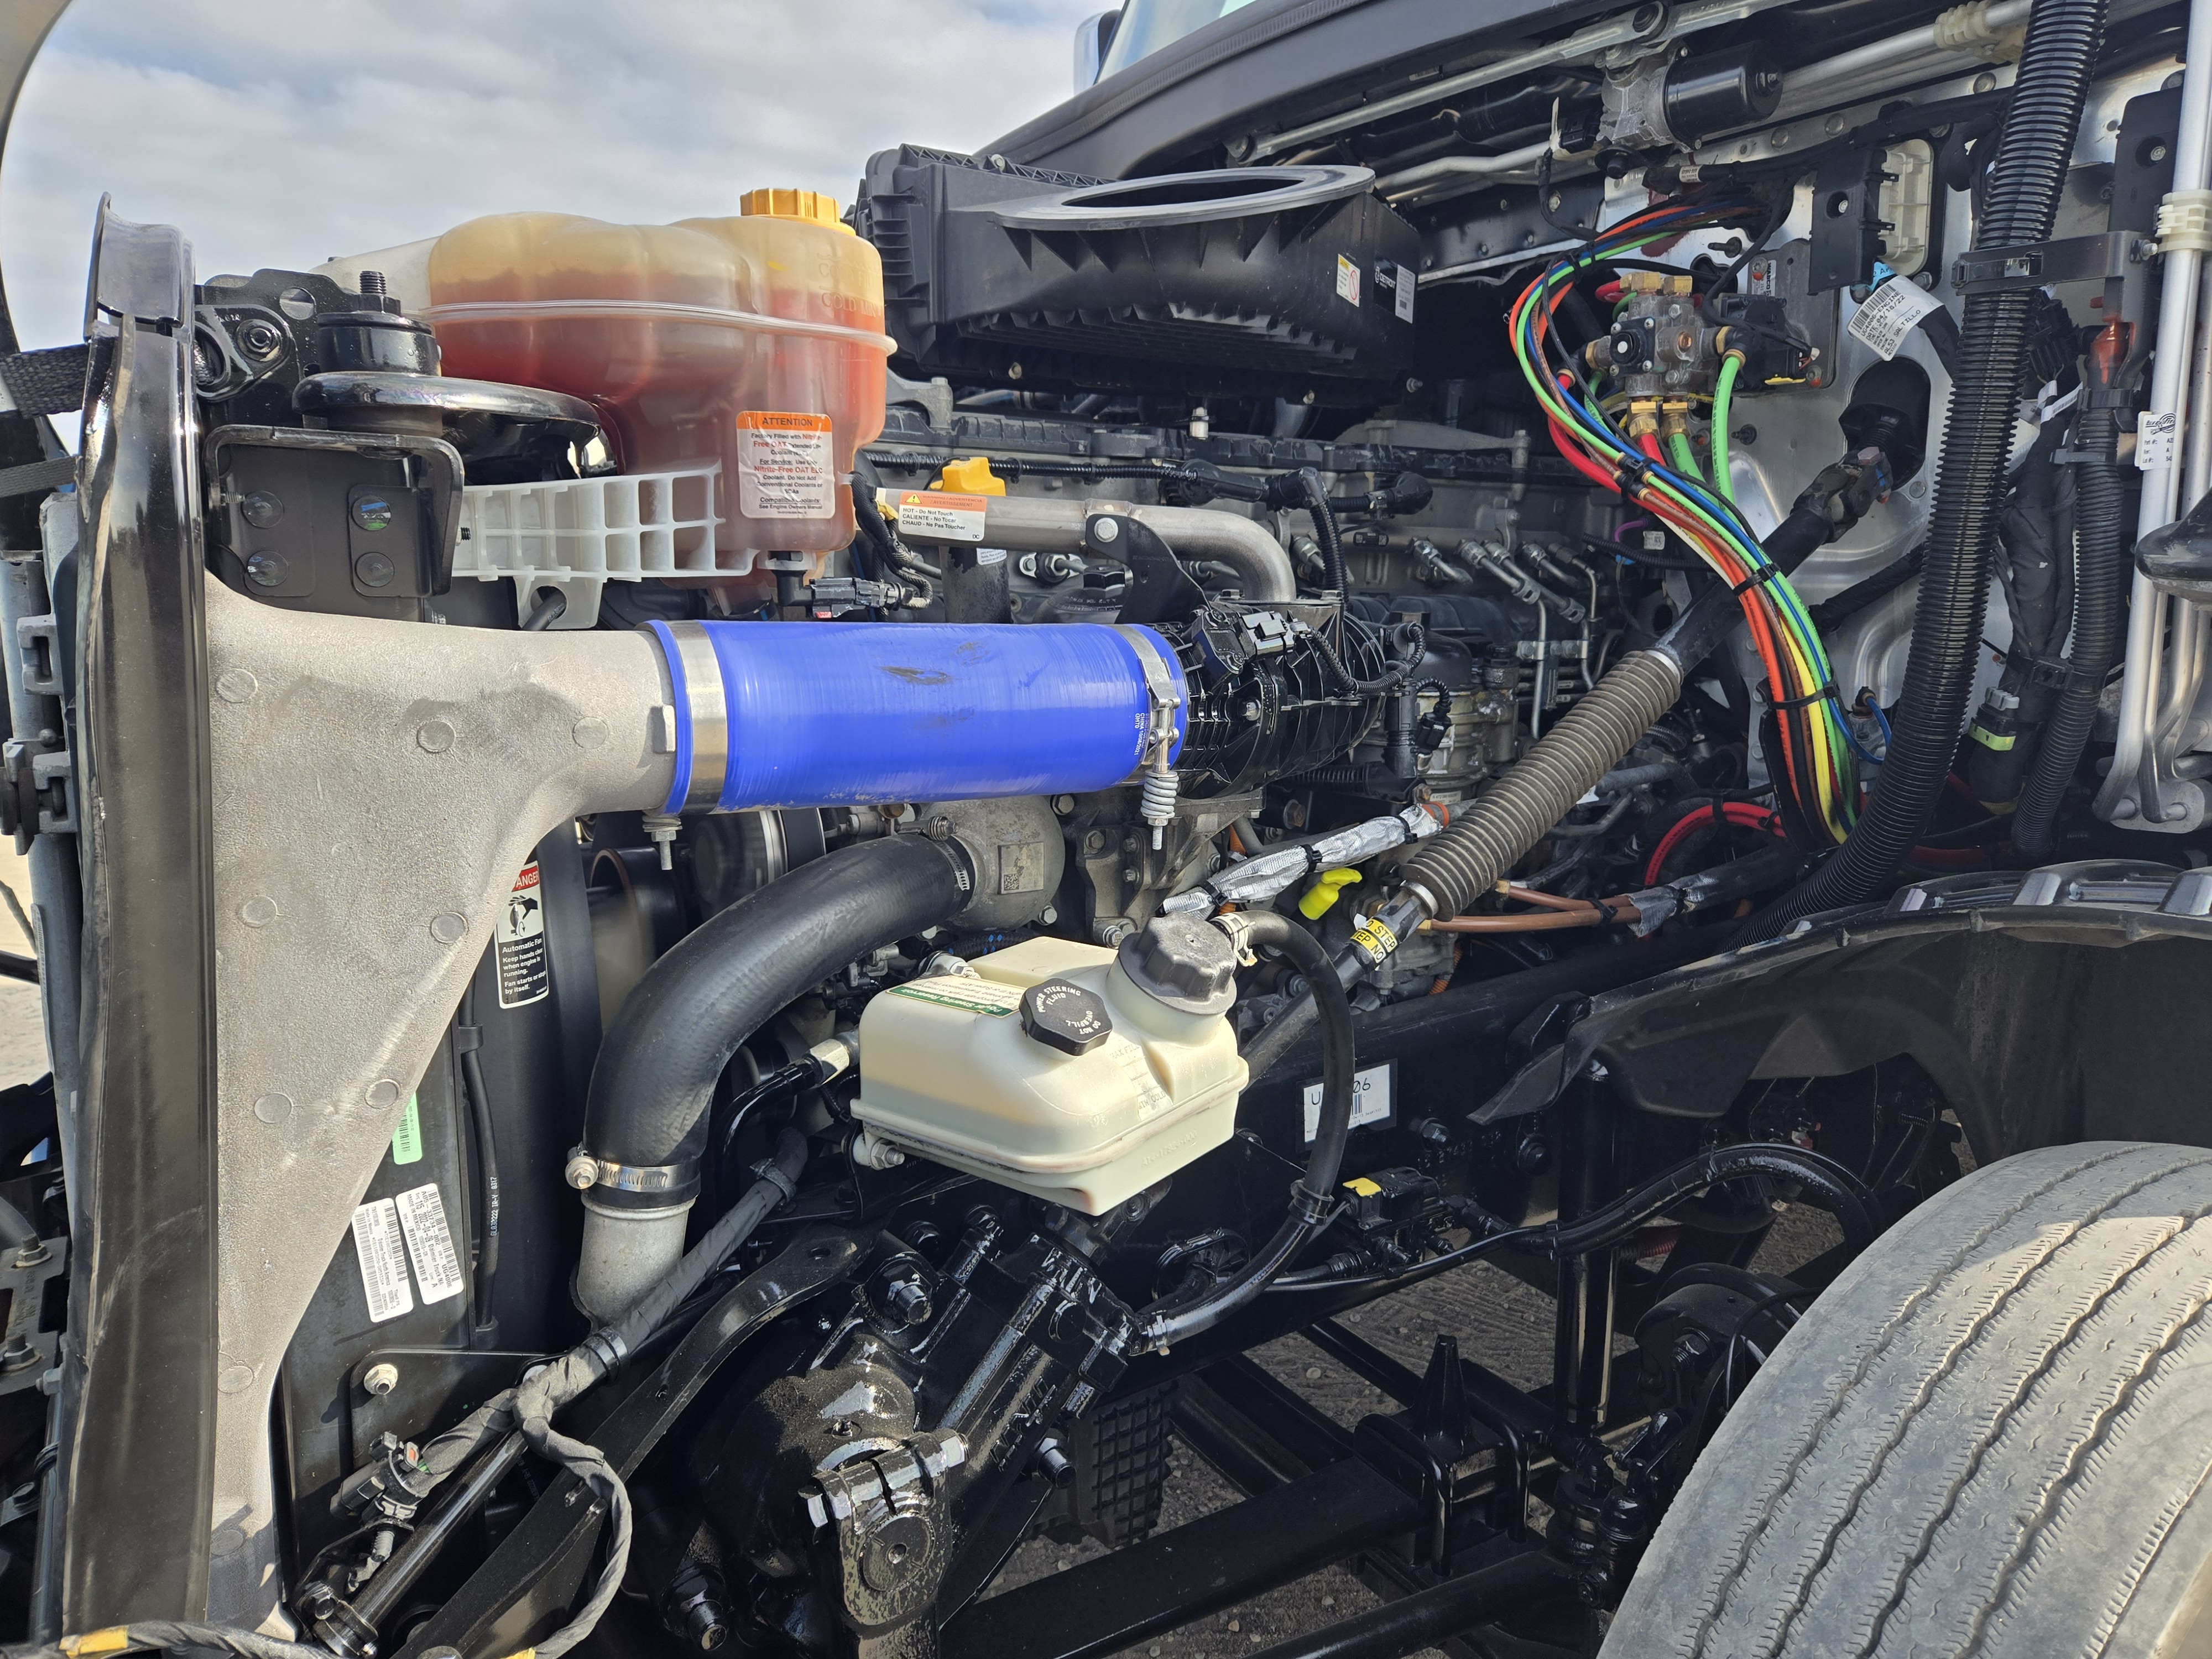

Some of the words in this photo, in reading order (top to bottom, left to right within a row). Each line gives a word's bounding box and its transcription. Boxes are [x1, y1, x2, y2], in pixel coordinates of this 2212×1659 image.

[1380, 272, 1396, 289] DETROIT
[822, 292, 857, 312] COLD
[1860, 290, 1901, 336] UG4006-ENGINE
[1893, 310, 1921, 337] SALTILLO
[762, 417, 813, 426] ATTENTION
[1134, 730, 1144, 755] 10/08/2021
[515, 870, 539, 888] ANGER
[1374, 925, 1396, 948] STEP
[502, 941, 535, 953] Automatic
[1353, 931, 1371, 942] TEP
[1370, 943, 1384, 960] NO
[519, 952, 535, 960] hands
[520, 958, 536, 967] engine
[504, 968, 528, 978] running.
[517, 977, 533, 985] starts
[514, 984, 530, 993] itself.
[900, 988, 940, 1000] Reservoir
[940, 995, 975, 1007] Steering
[1036, 993, 1046, 1013] POWER
[1044, 986, 1081, 996] STEERING
[1046, 993, 1066, 1005] FLUID
[1065, 1010, 1093, 1028] OVERFILL
[1092, 1020, 1101, 1029] DO
[1079, 1026, 1094, 1035] NOT
[1151, 1091, 1166, 1103] COLD
[415, 1201, 425, 1209] 115
[413, 1214, 421, 1231] MEXICO
[418, 1212, 434, 1243] 2022-04-09
[421, 1191, 441, 1245] A05-33734-002
[442, 1264, 452, 1288] UG4006
[428, 1244, 437, 1262] Daimler
